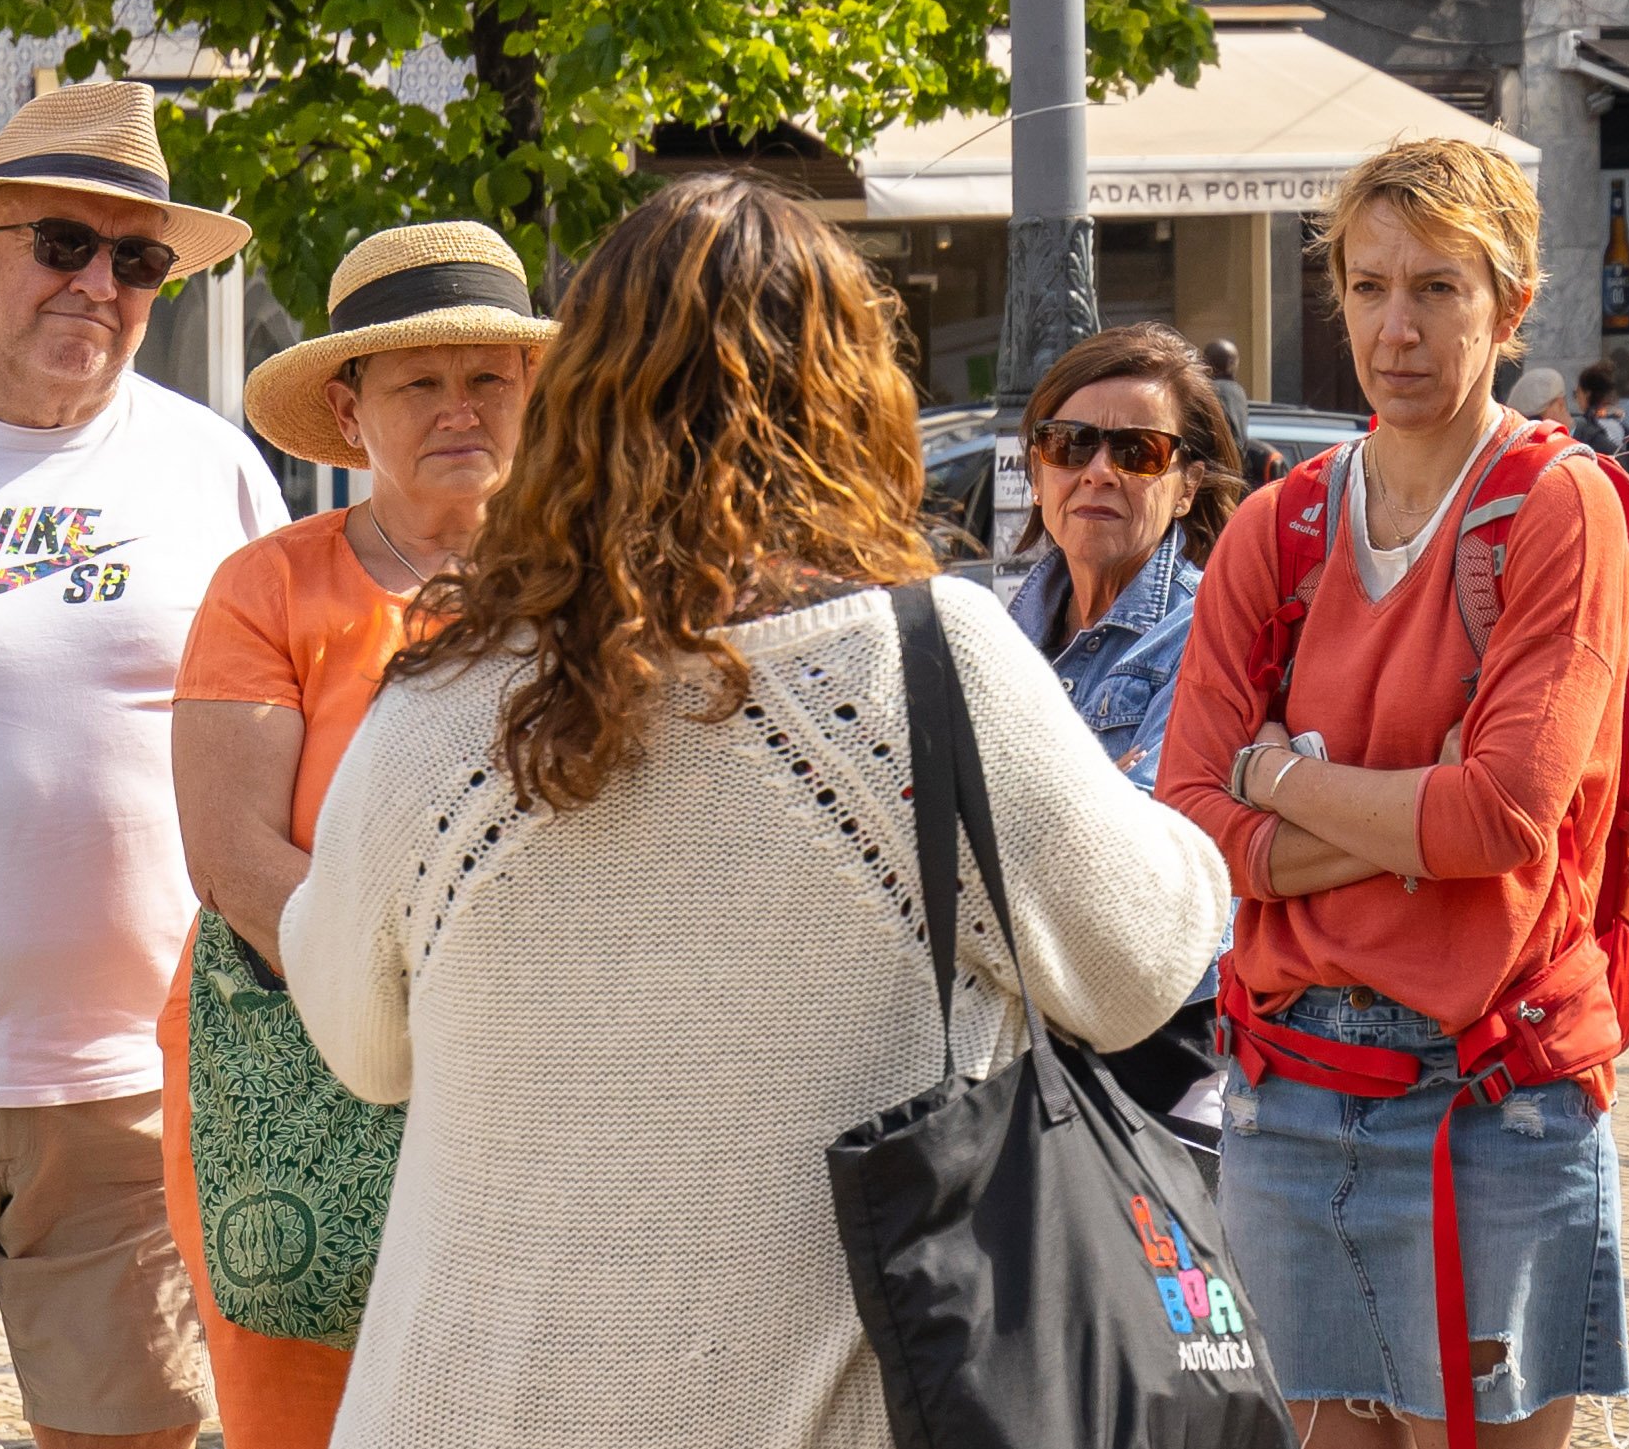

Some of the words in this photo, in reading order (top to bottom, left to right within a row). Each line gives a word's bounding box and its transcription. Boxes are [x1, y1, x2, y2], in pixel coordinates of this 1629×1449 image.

[1087, 182, 1194, 203] ADARIA
[1289, 520, 1320, 537] deuter
[63, 563, 131, 604] SB
